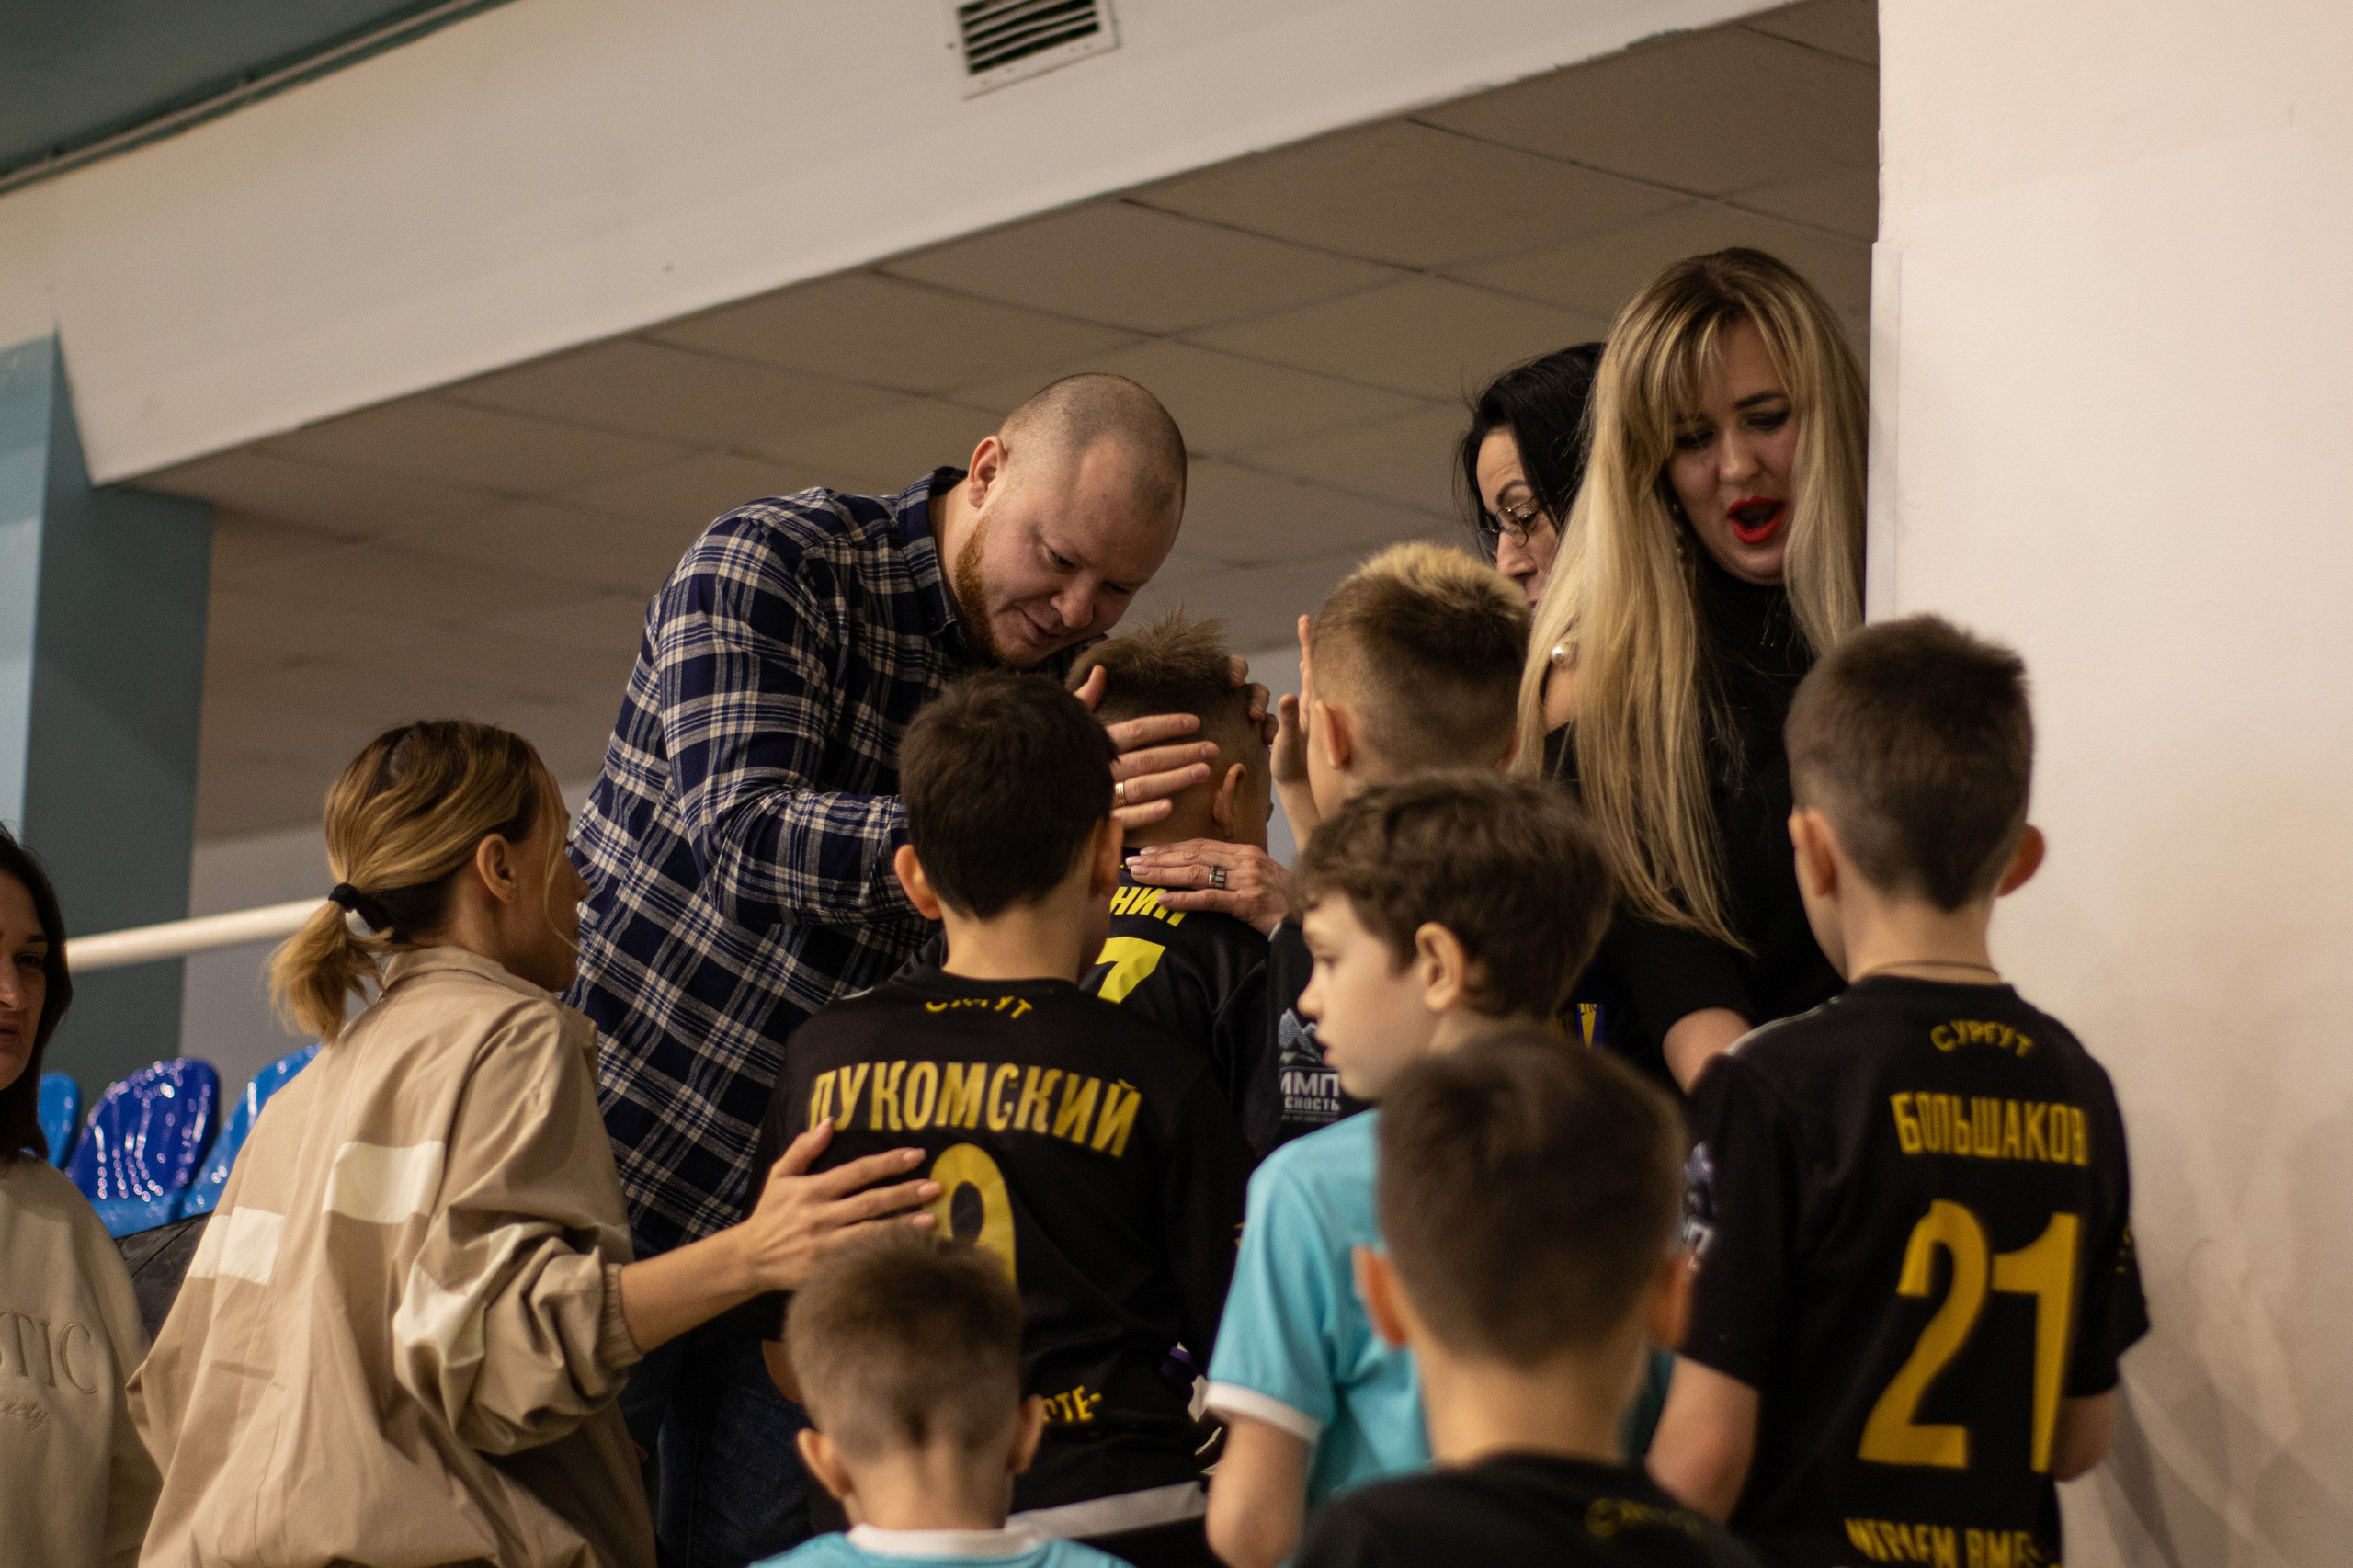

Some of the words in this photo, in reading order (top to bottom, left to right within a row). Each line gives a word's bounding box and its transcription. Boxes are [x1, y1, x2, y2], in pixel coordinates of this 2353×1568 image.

[809, 1059, 1142, 1158] ЛУКОМСКИЙ
[1889, 1091, 2090, 1167] БОЛЬШАКОВ
[1857, 1199, 2081, 1474] 21
